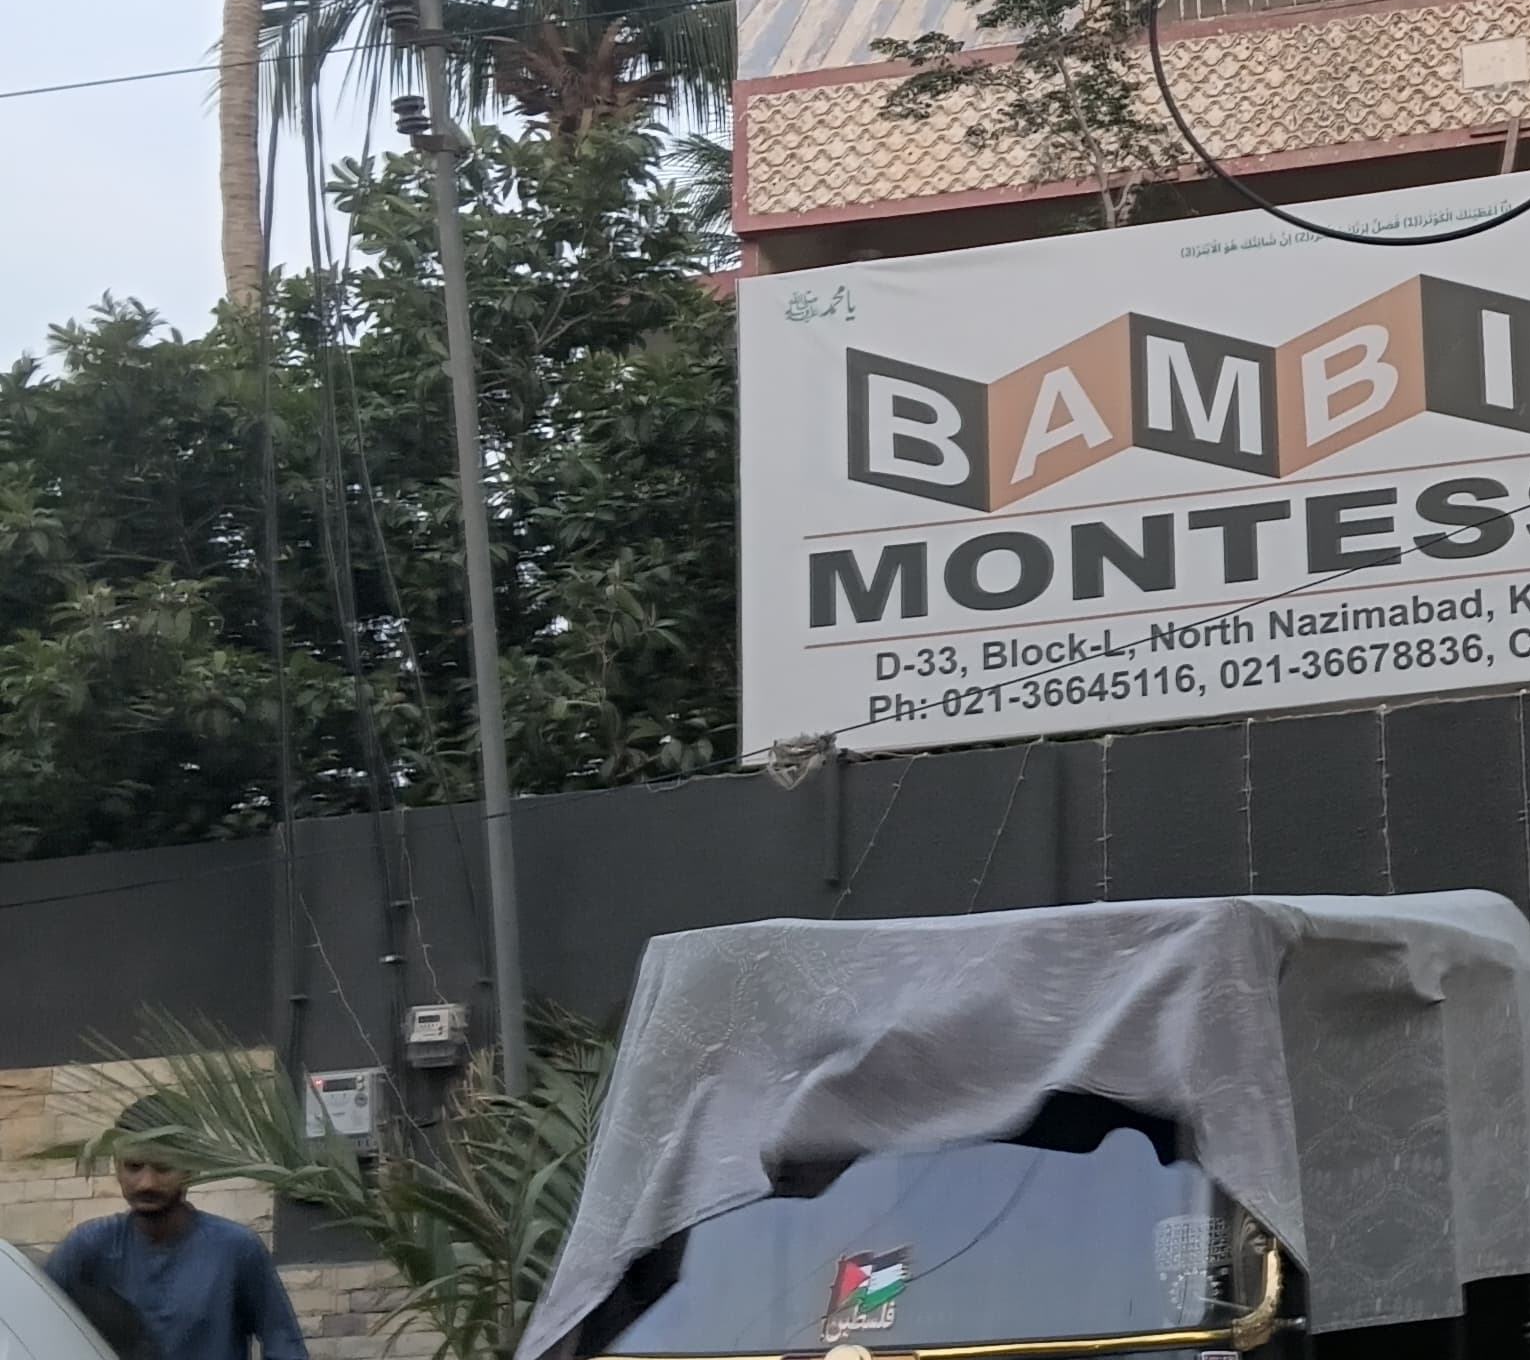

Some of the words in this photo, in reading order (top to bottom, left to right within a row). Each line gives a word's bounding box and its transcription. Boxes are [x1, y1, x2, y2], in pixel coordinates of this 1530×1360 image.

[869, 692, 928, 723] Ph:
[942, 662, 1207, 718] 021-36645116,
[1219, 631, 1496, 691] 021-36678836,
[875, 646, 969, 682] D-33,
[982, 628, 1137, 672] Block-L,
[1150, 615, 1256, 653] North
[1268, 588, 1496, 641] Nazimabad,
